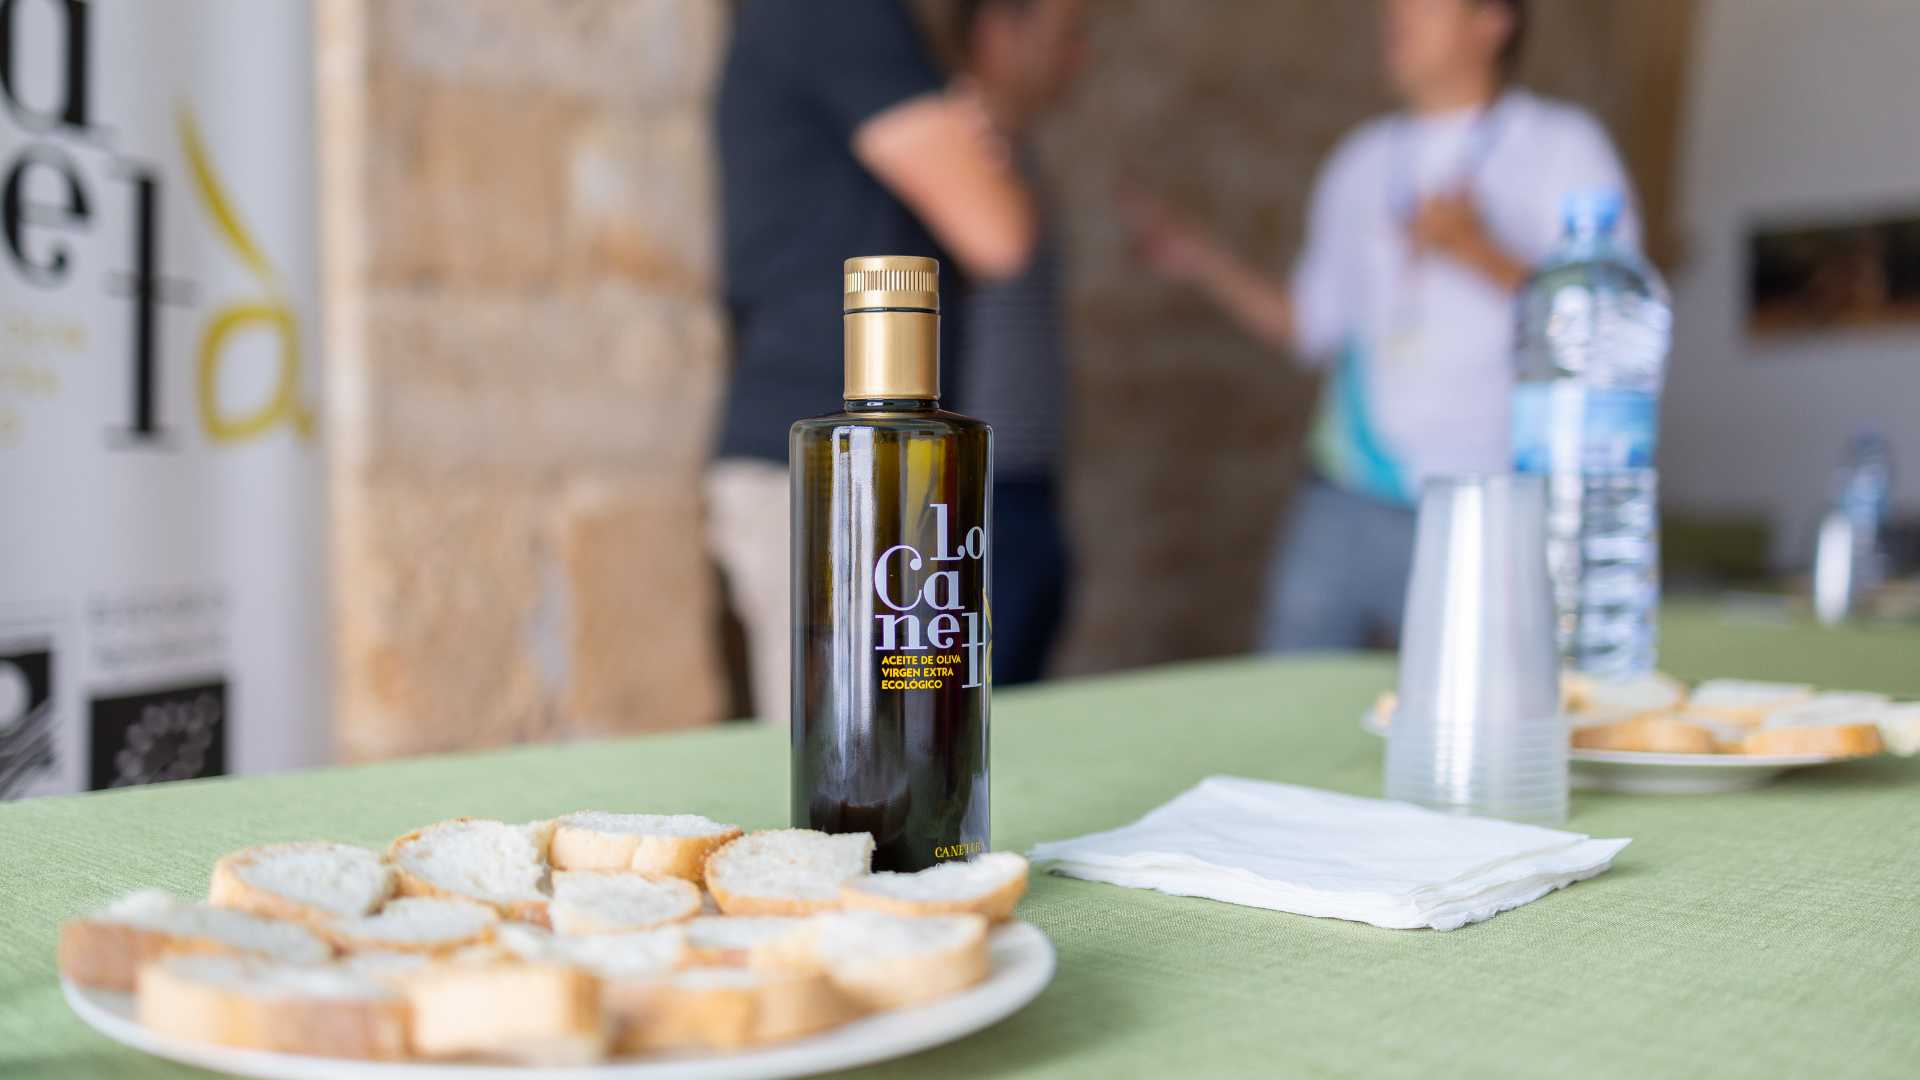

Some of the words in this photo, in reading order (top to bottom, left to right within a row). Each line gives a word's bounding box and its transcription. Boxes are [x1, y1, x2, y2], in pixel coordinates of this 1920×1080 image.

[875, 545, 965, 610] Ca
[881, 655, 918, 665] ACEITE
[921, 655, 934, 665] DE
[936, 655, 961, 664] OLIVA
[881, 667, 921, 677] VIRGEN
[923, 667, 954, 677] EXTRA
[881, 679, 943, 690] ECOLÓGICO
